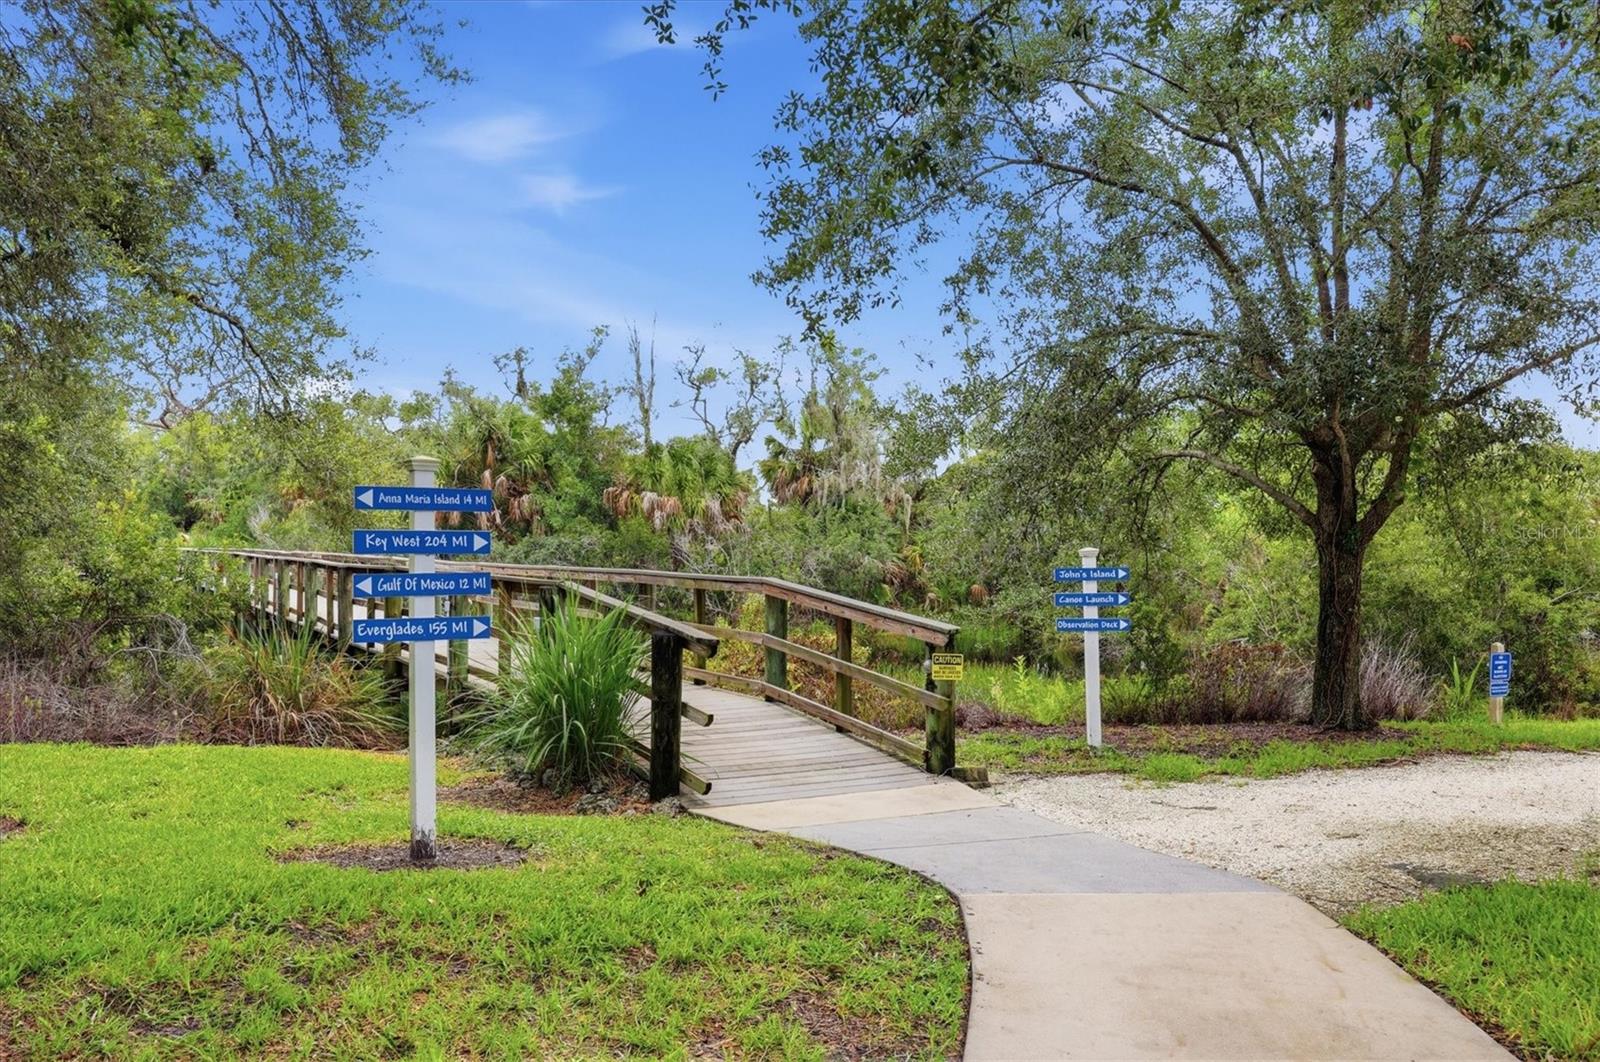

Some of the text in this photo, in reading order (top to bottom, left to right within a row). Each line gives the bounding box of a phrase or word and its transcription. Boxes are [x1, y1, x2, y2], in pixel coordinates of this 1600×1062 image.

[378, 492, 487, 505] Anna Maria Island 14 MI
[365, 533, 467, 551] Key West 204 MI
[1058, 569, 1116, 579] John's Island
[377, 577, 486, 592] Gulf Of Mexico 12 MI
[1058, 595, 1114, 603] Canoe Launch
[1057, 621, 1099, 629] Observation
[357, 621, 467, 641] Everglades 155 MI
[934, 656, 961, 664] CAUTION
